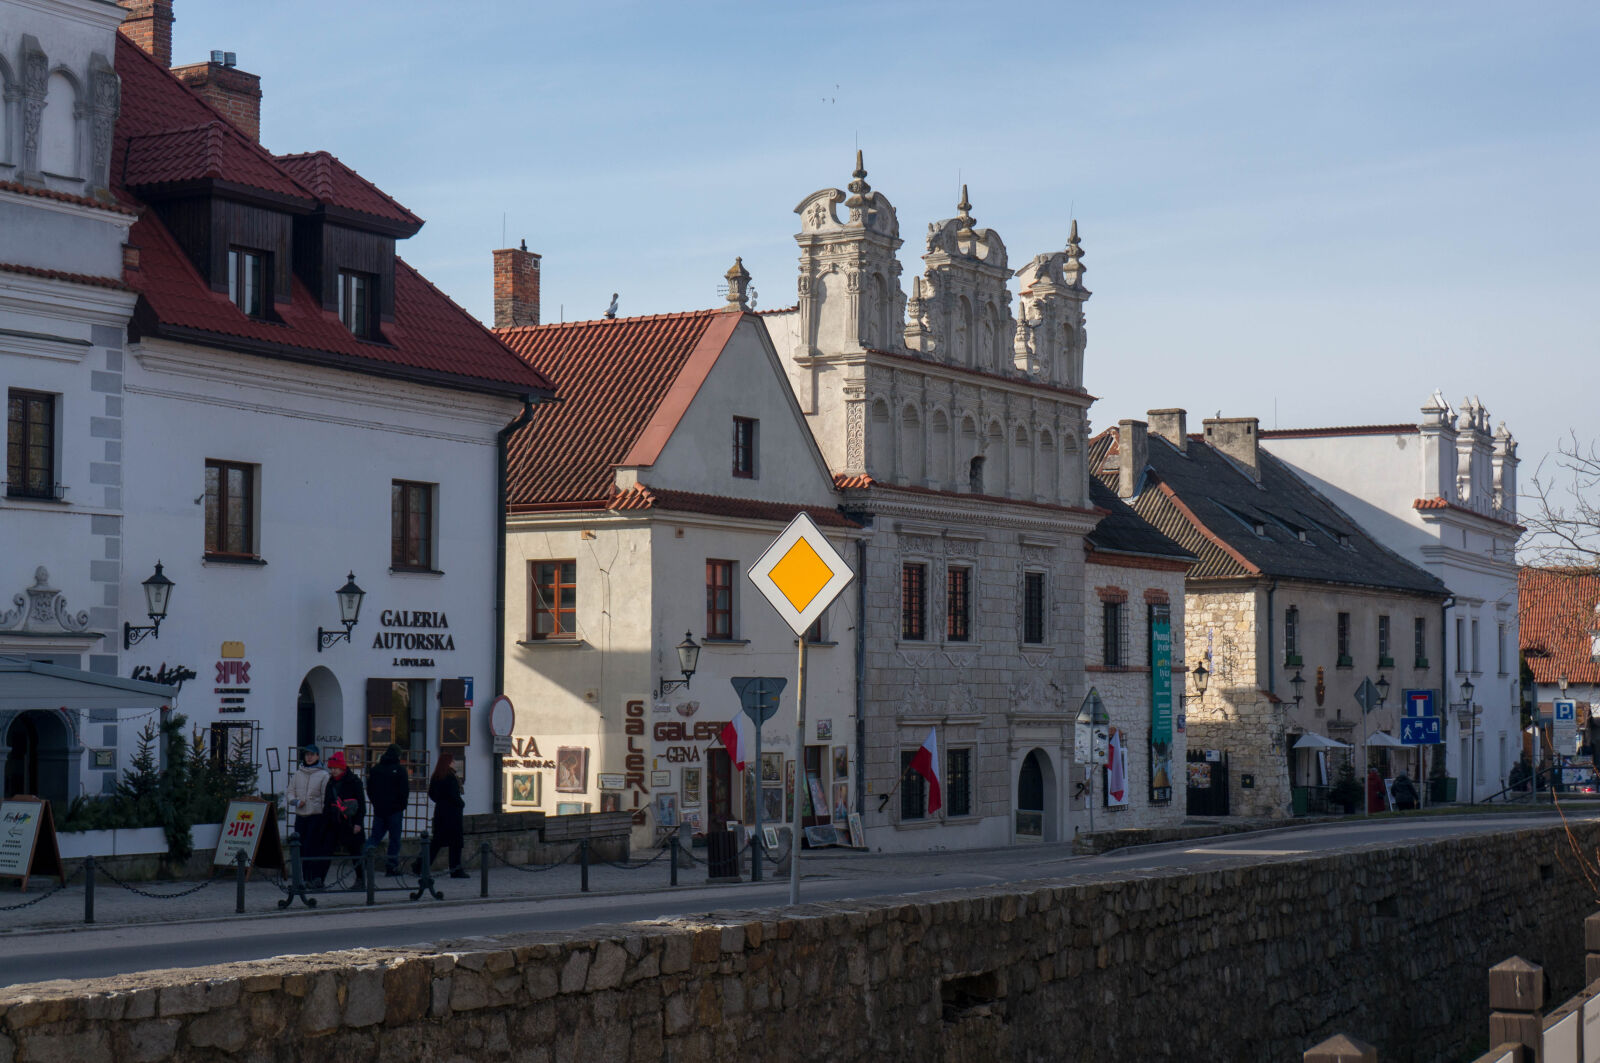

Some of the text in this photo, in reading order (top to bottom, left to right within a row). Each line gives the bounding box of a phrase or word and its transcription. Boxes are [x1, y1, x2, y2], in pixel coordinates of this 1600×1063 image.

[381, 610, 448, 628] GALERIA
[372, 632, 455, 651] AUTORSKA
[653, 689, 659, 700] 9
[1560, 705, 1570, 718] P
